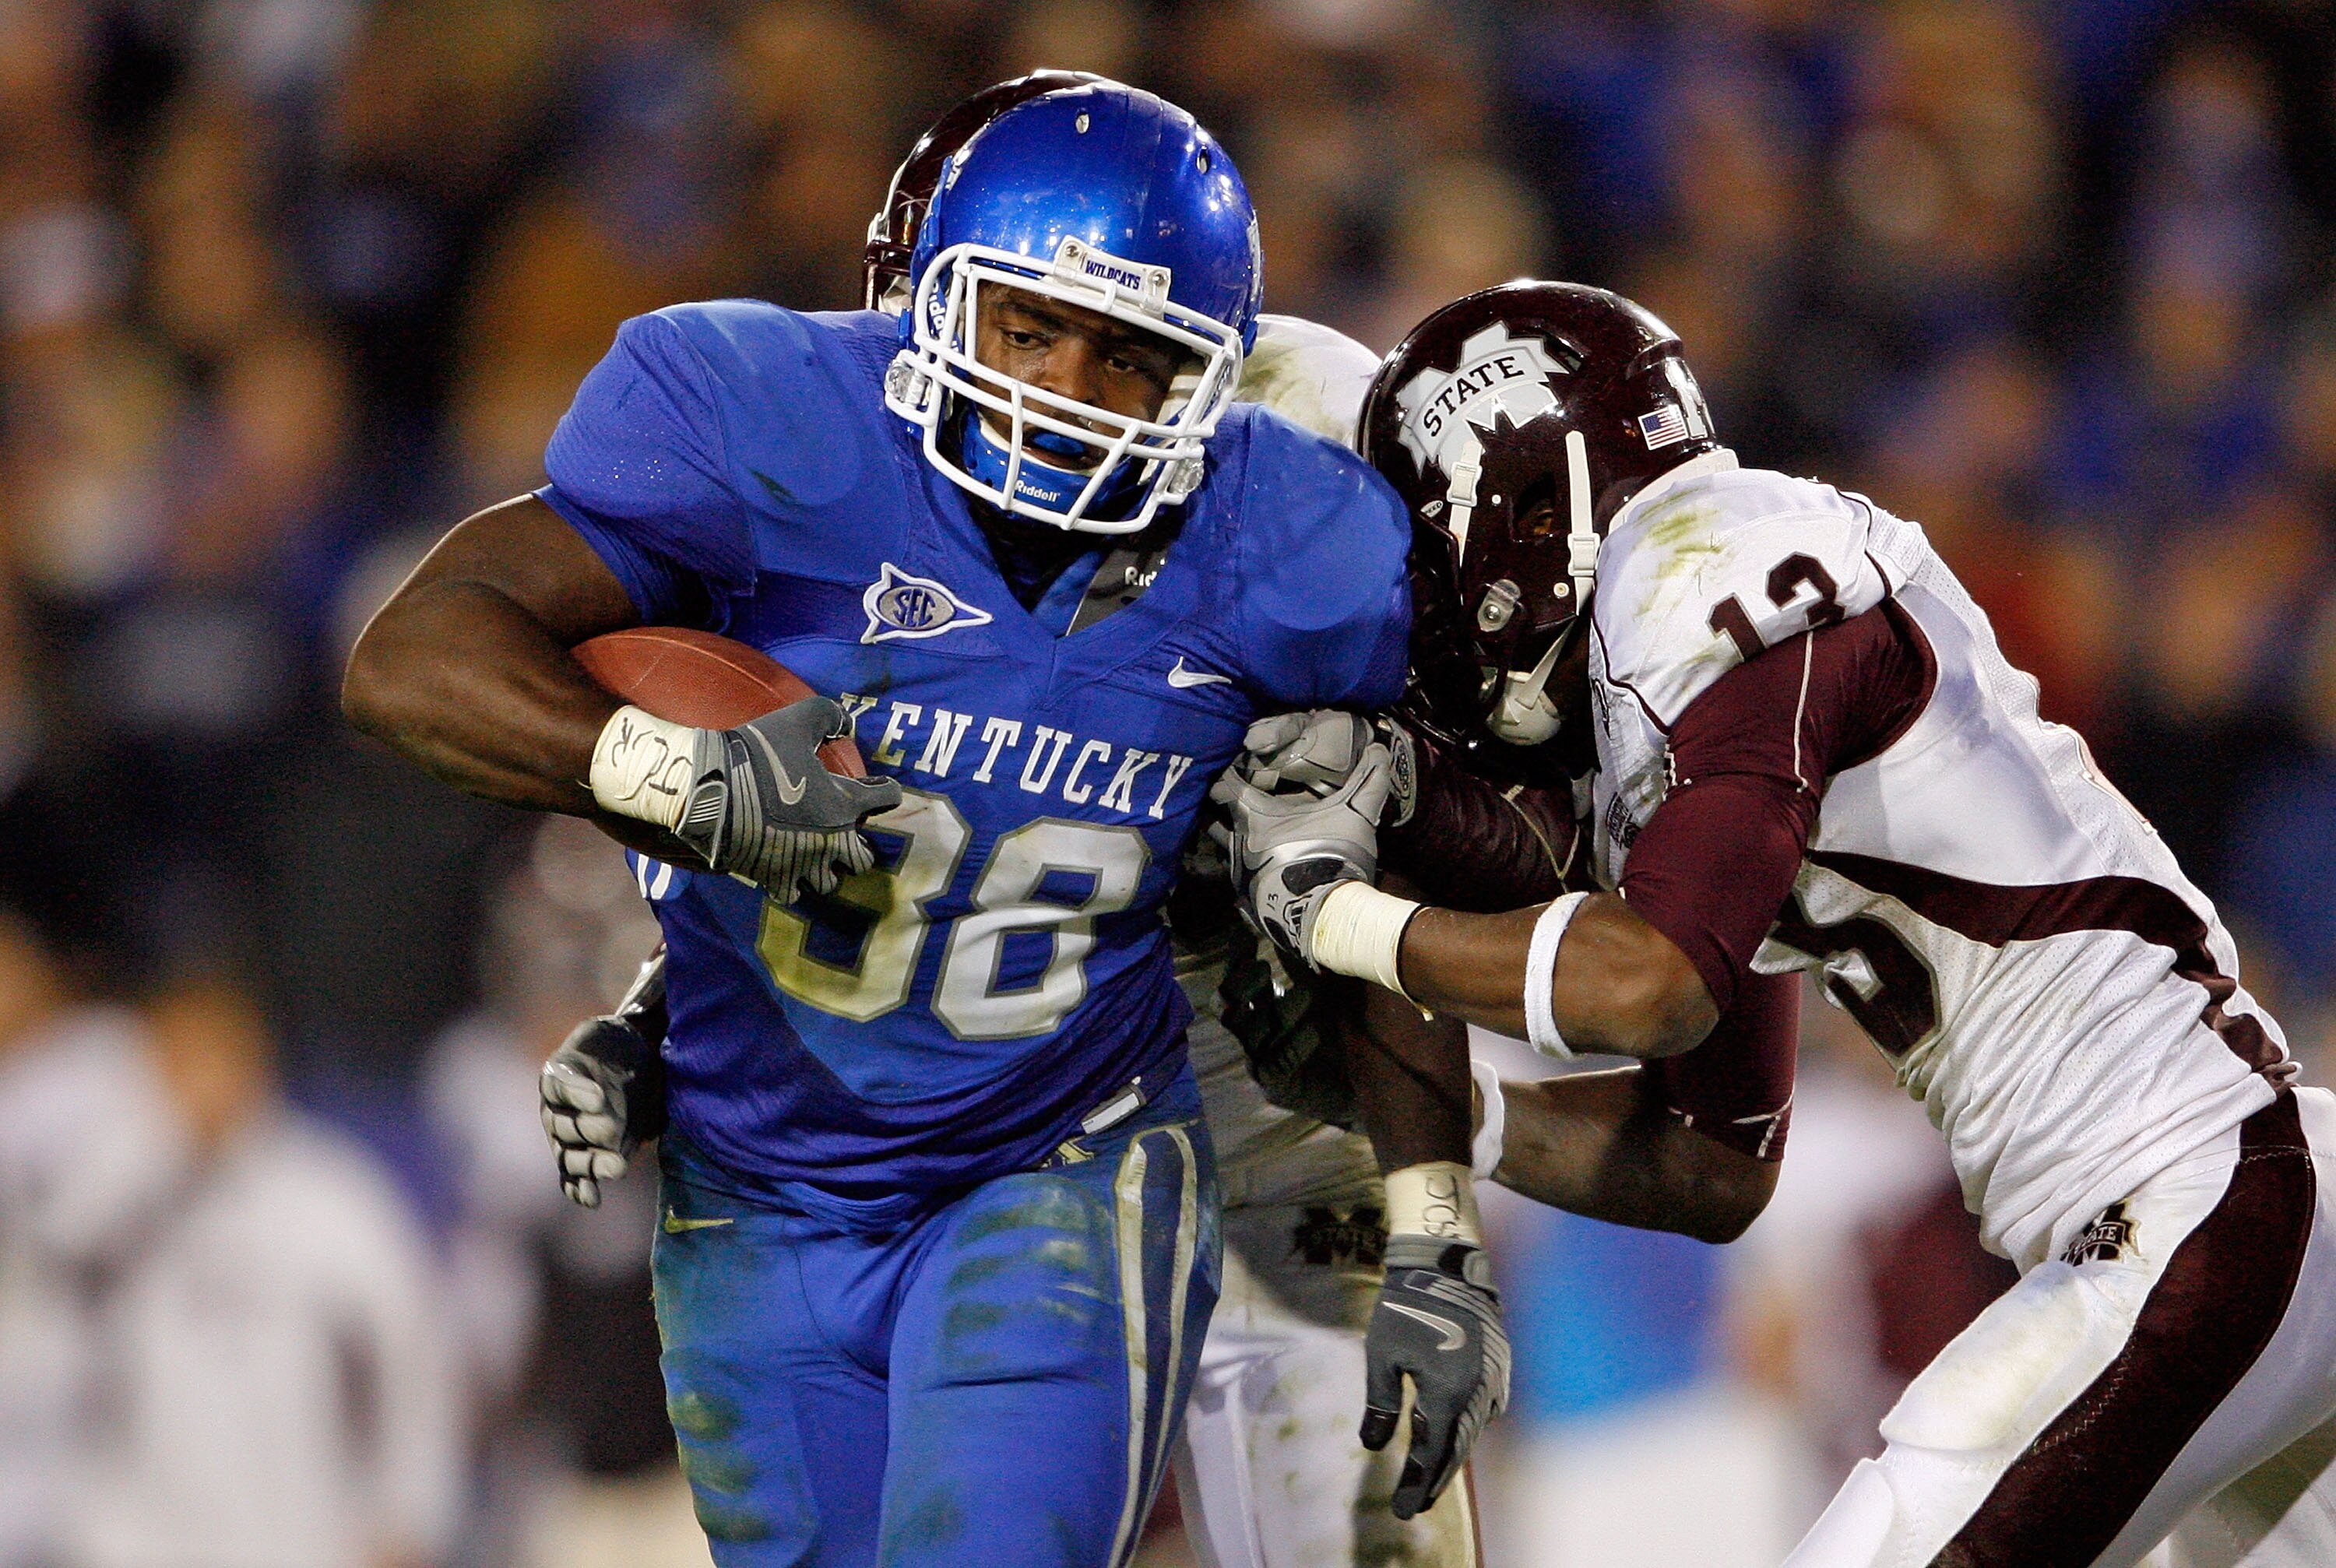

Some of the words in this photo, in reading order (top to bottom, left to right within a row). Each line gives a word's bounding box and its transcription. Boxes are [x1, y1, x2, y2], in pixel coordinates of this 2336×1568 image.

[1085, 260, 1141, 290] WILDCATS
[1422, 356, 1525, 437] STATE
[1015, 480, 1057, 502] Riddell
[893, 589, 936, 628] SEC
[840, 691, 1194, 820] KENTUCKY
[752, 787, 1152, 1041] 38
